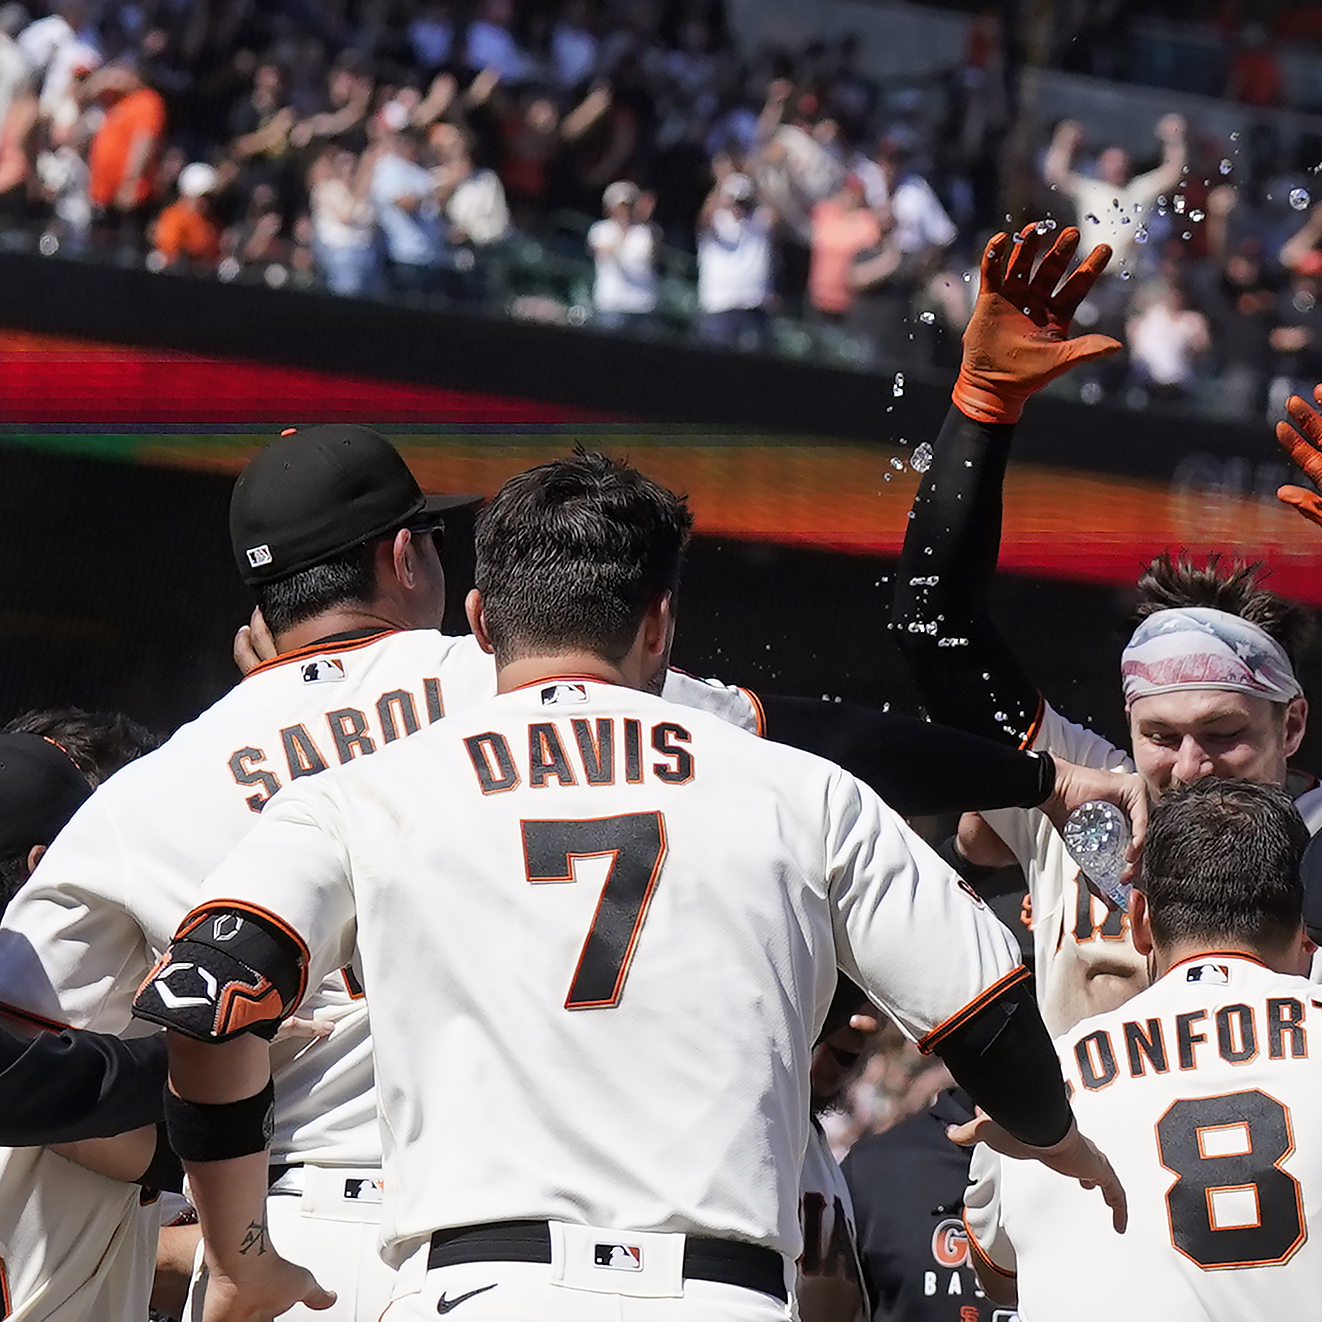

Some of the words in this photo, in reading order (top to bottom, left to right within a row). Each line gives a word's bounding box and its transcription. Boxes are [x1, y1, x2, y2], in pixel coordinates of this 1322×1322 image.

[462, 717, 696, 796] DAVIS
[519, 810, 669, 1010] 7
[1154, 1087, 1309, 1272] 8
